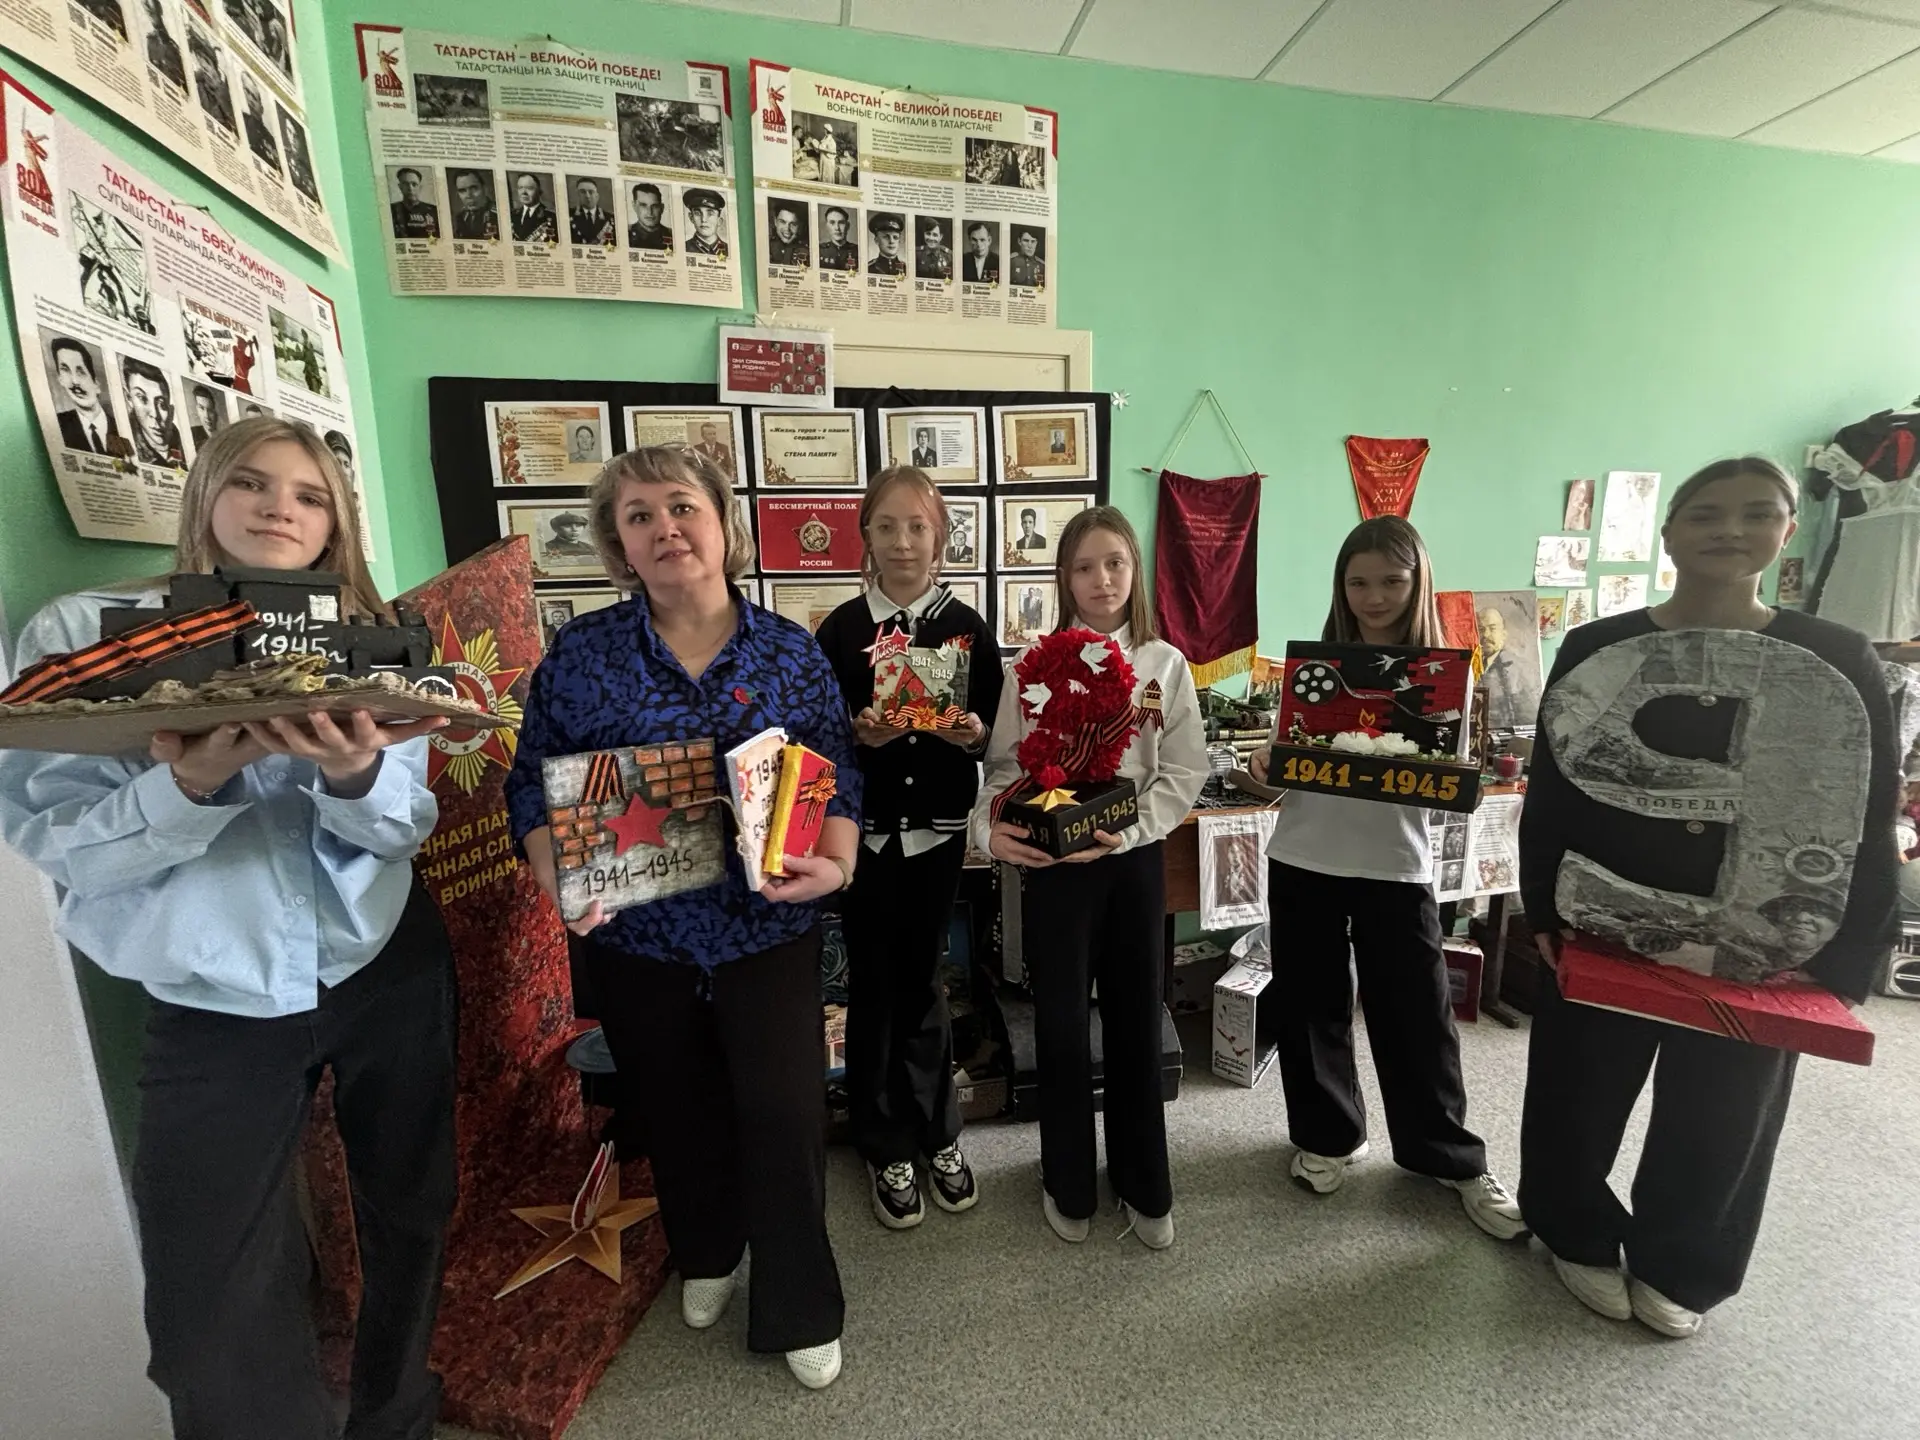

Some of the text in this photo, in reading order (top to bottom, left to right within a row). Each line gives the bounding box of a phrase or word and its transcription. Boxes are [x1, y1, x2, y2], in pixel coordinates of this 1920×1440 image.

[434, 43, 516, 63] ТАТАРСТАН
[530, 51, 598, 72] ВЕЛИКОЙ
[601, 63, 662, 81] ПОБЕДЕ!
[456, 61, 646, 92] ТАТАРСТАНЦЫ НА ЗАЩИТЕ ГРАНИЦ
[815, 84, 882, 108] ТАТАРСТАН
[894, 102, 950, 117] ВЕЛИКОЙ
[953, 107, 1002, 122] ПОБЕДЕ!
[827, 101, 993, 133] ВОЕННЫЕ ГОСПИТАЛИ В ТАТАРСТАНЕ
[98, 184, 145, 222] СУГЫШ
[146, 213, 217, 263] ЕЛЛАРЫНДА
[102, 163, 187, 230] ТАТАРСТАН
[201, 227, 237, 260] БӨЕК
[769, 502, 833, 510] БЕССМЕРТНЫЙ
[255, 611, 324, 633] 941-
[911, 655, 936, 667] 1941-
[931, 669, 954, 680] 1945
[1283, 757, 1351, 788] 1941
[1381, 768, 1461, 801] 1945
[1063, 797, 1137, 843] 1941-1945
[420, 824, 474, 857] ЧНАЯ
[440, 856, 518, 906] ВОИНАМ
